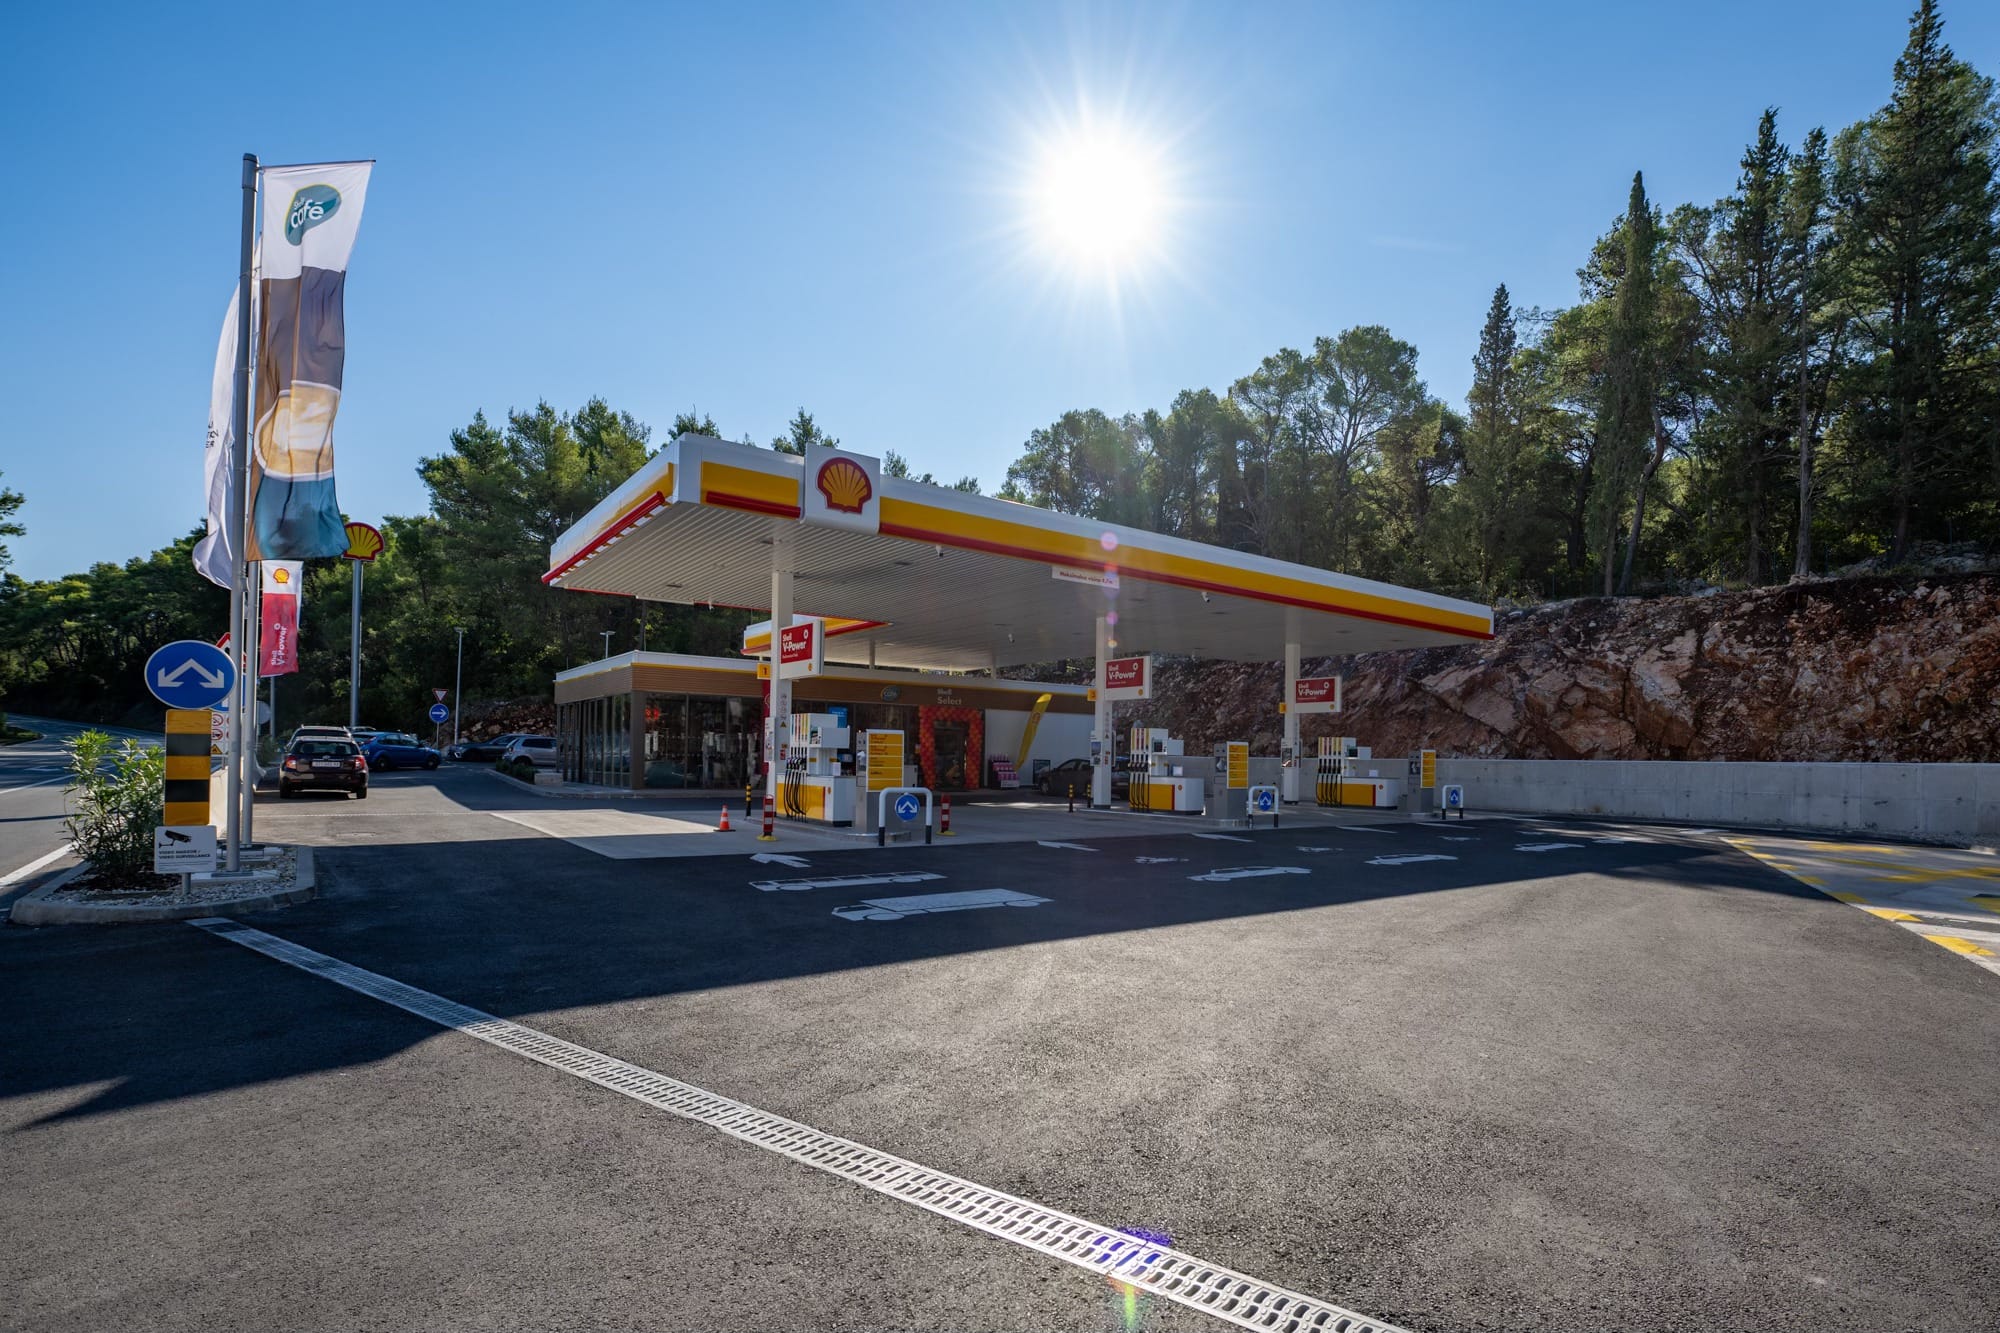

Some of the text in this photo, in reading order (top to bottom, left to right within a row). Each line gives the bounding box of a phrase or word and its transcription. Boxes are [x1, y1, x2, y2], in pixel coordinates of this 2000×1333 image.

[782, 641, 807, 653] V-Power
[1108, 671, 1136, 680] V-Power
[937, 696, 962, 705] Select
